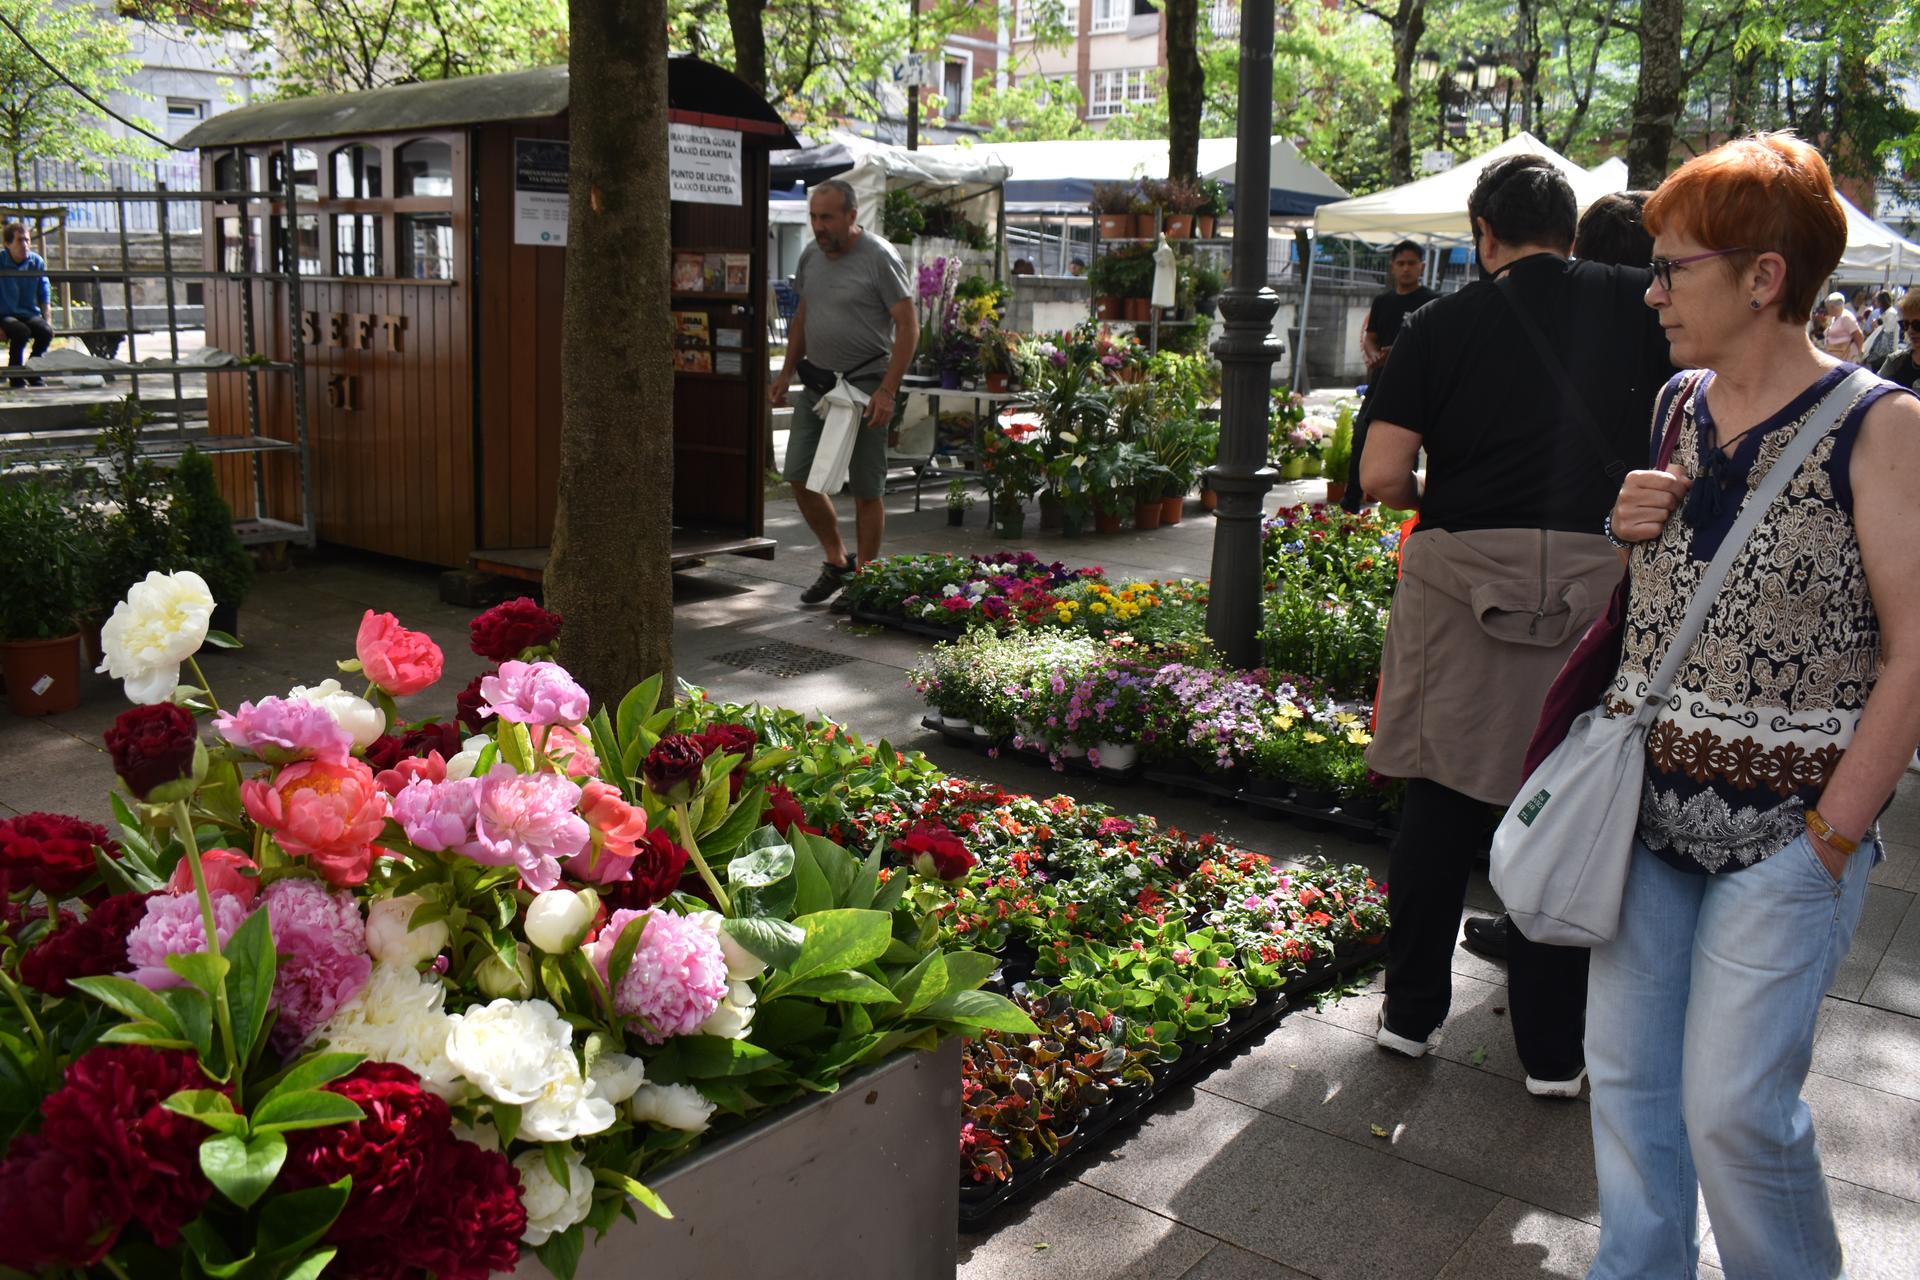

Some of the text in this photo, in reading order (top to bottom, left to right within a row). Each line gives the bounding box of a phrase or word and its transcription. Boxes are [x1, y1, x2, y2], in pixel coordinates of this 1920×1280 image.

[699, 148, 733, 160] ELKARTEA
[671, 169, 736, 184] PUNTO DE LECTURA
[699, 184, 734, 195] ELKARTEA
[301, 311, 405, 352] SEFT
